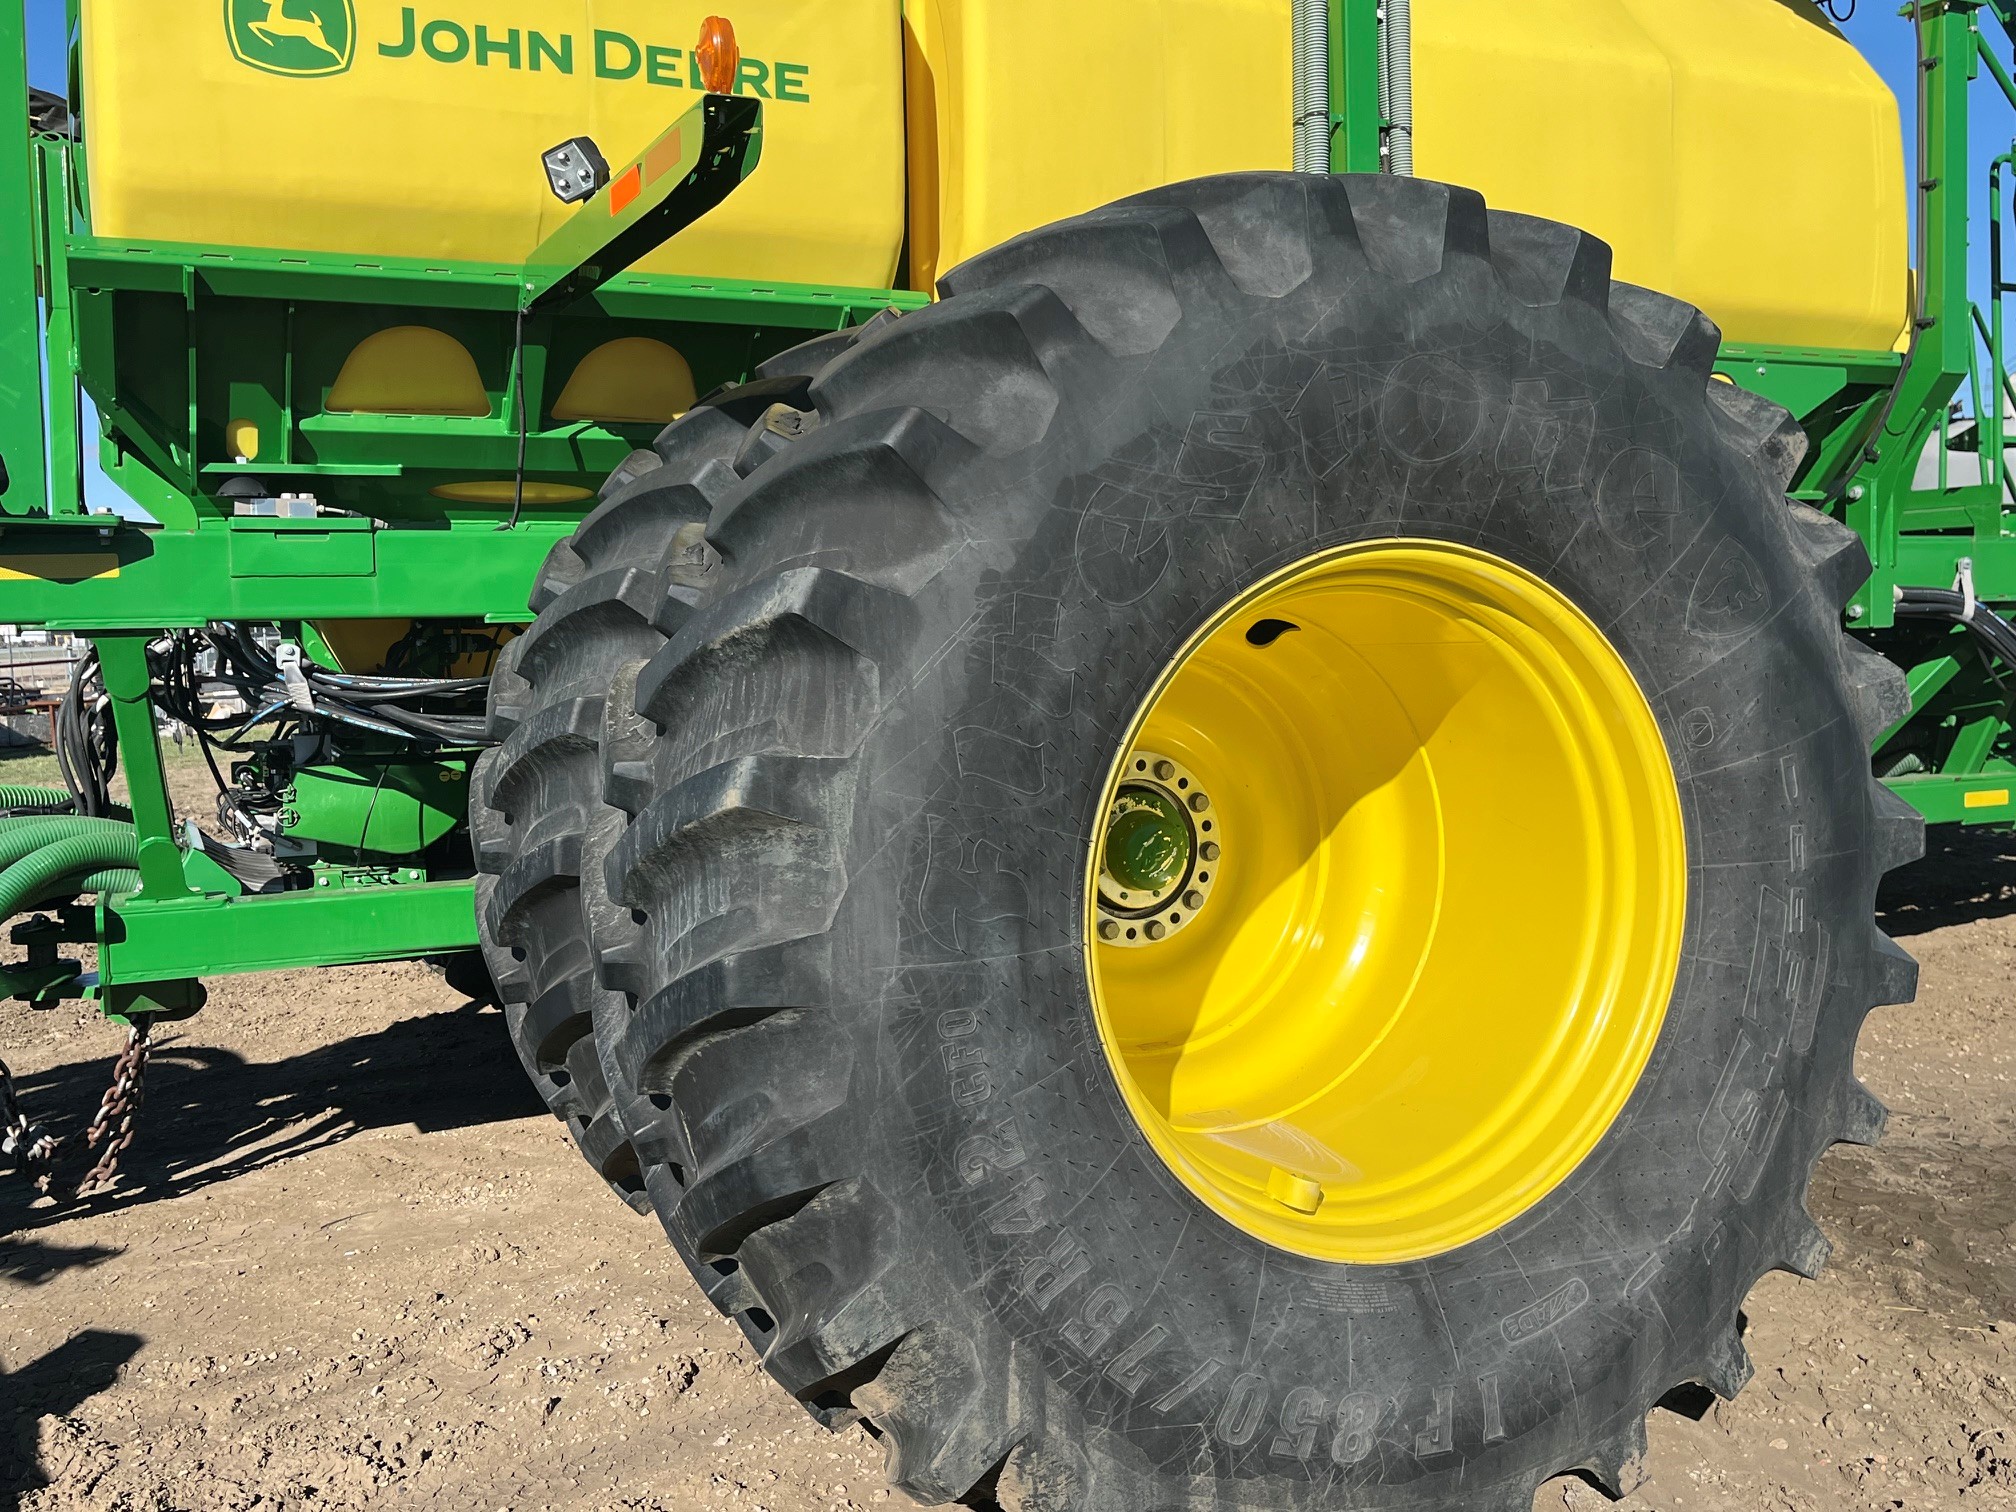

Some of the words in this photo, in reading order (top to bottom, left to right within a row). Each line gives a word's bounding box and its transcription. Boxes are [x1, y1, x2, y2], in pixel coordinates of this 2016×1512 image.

[378, 7, 573, 75] JOHN
[918, 352, 1682, 952] Firestone
[937, 1006, 992, 1109] CFO
[957, 1116, 1385, 1466] 850/75R42
[1415, 1370, 1505, 1461] IF
